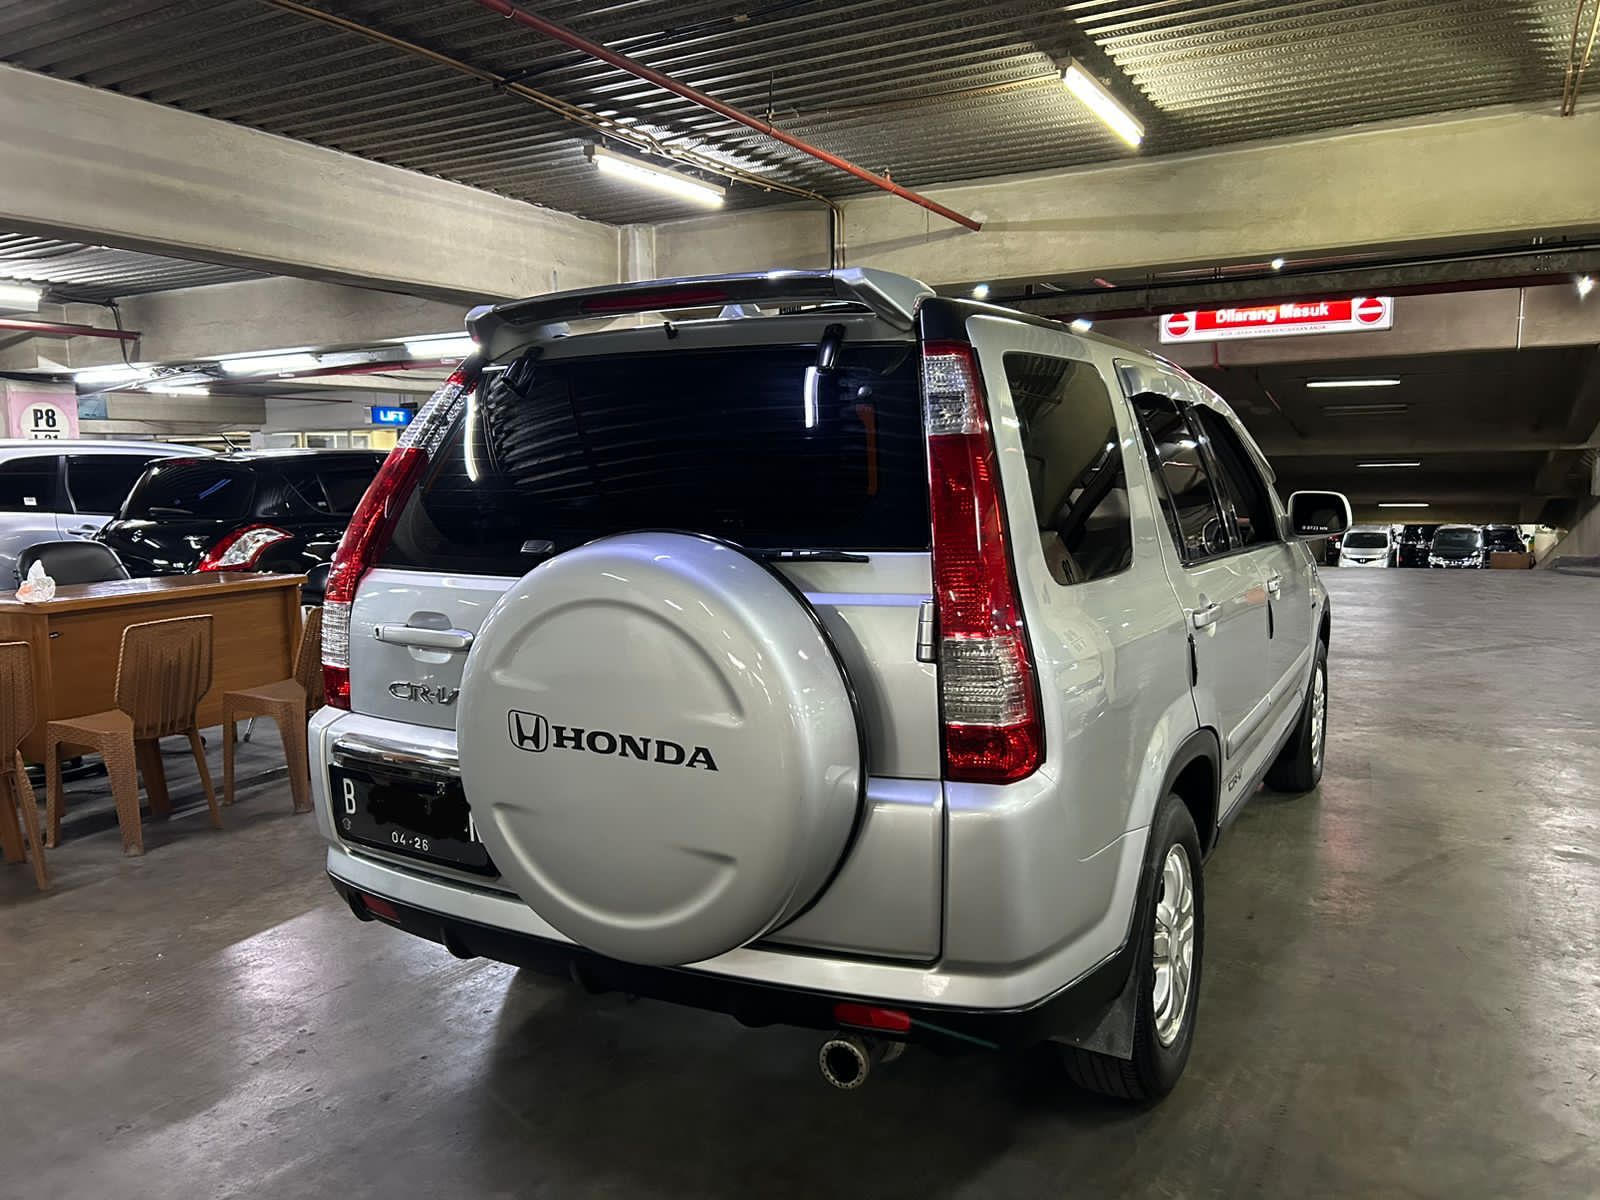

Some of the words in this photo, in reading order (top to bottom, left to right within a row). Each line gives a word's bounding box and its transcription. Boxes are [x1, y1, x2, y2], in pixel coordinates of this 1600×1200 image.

[1215, 309, 1277, 323] Dilarang
[1280, 303, 1328, 319] Masuk
[33, 408, 57, 428] P8
[380, 410, 405, 422] LIFT
[551, 725, 719, 771] HONDA
[343, 778, 356, 814] B
